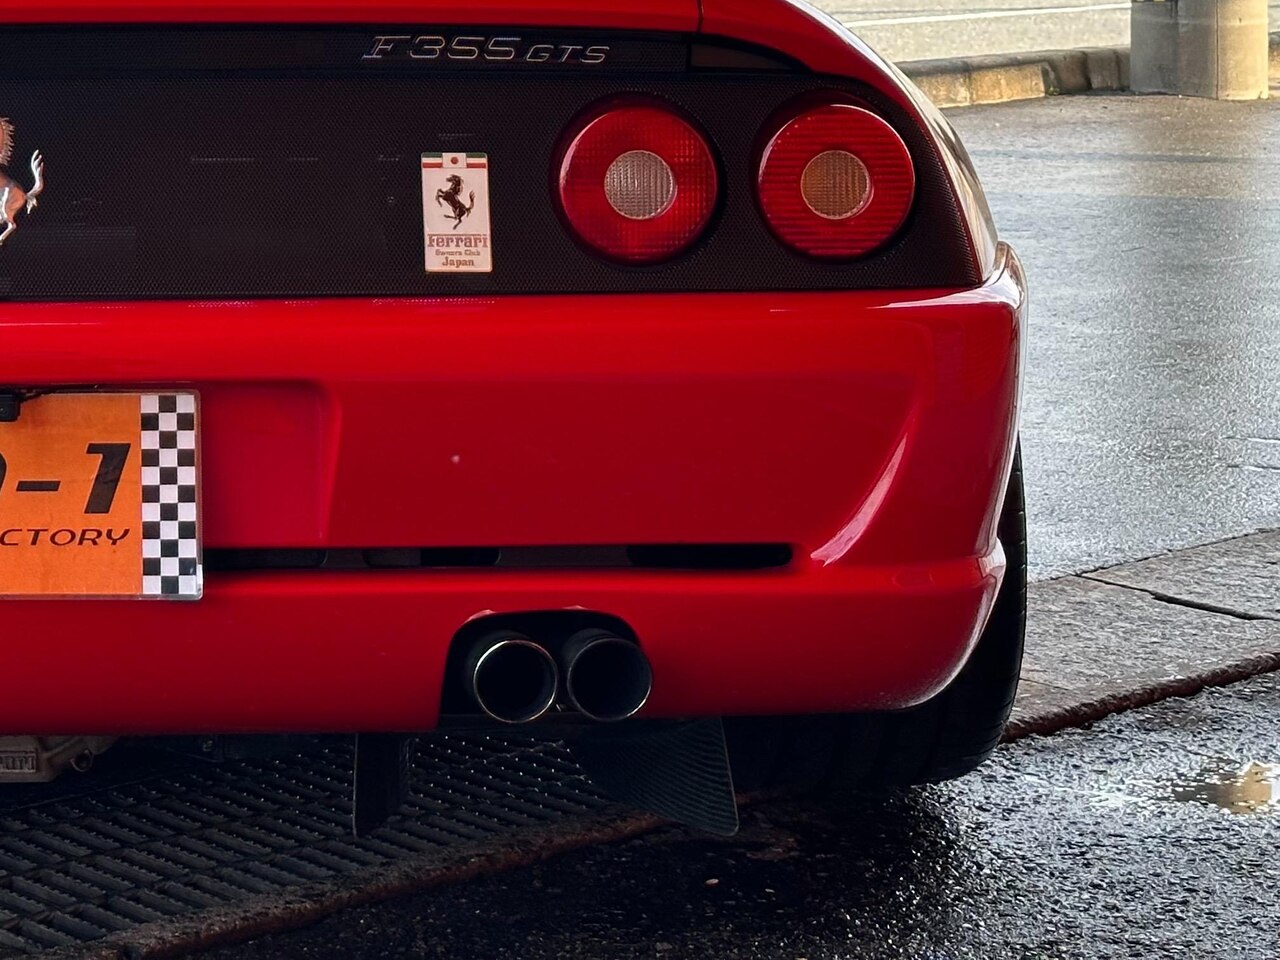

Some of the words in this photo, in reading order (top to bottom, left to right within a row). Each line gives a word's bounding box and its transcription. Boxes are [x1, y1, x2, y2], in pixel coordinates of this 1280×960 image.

[361, 35, 521, 60] F355
[523, 44, 610, 63] GTS
[427, 233, 488, 248] Ferrari
[441, 256, 475, 268] Japan
